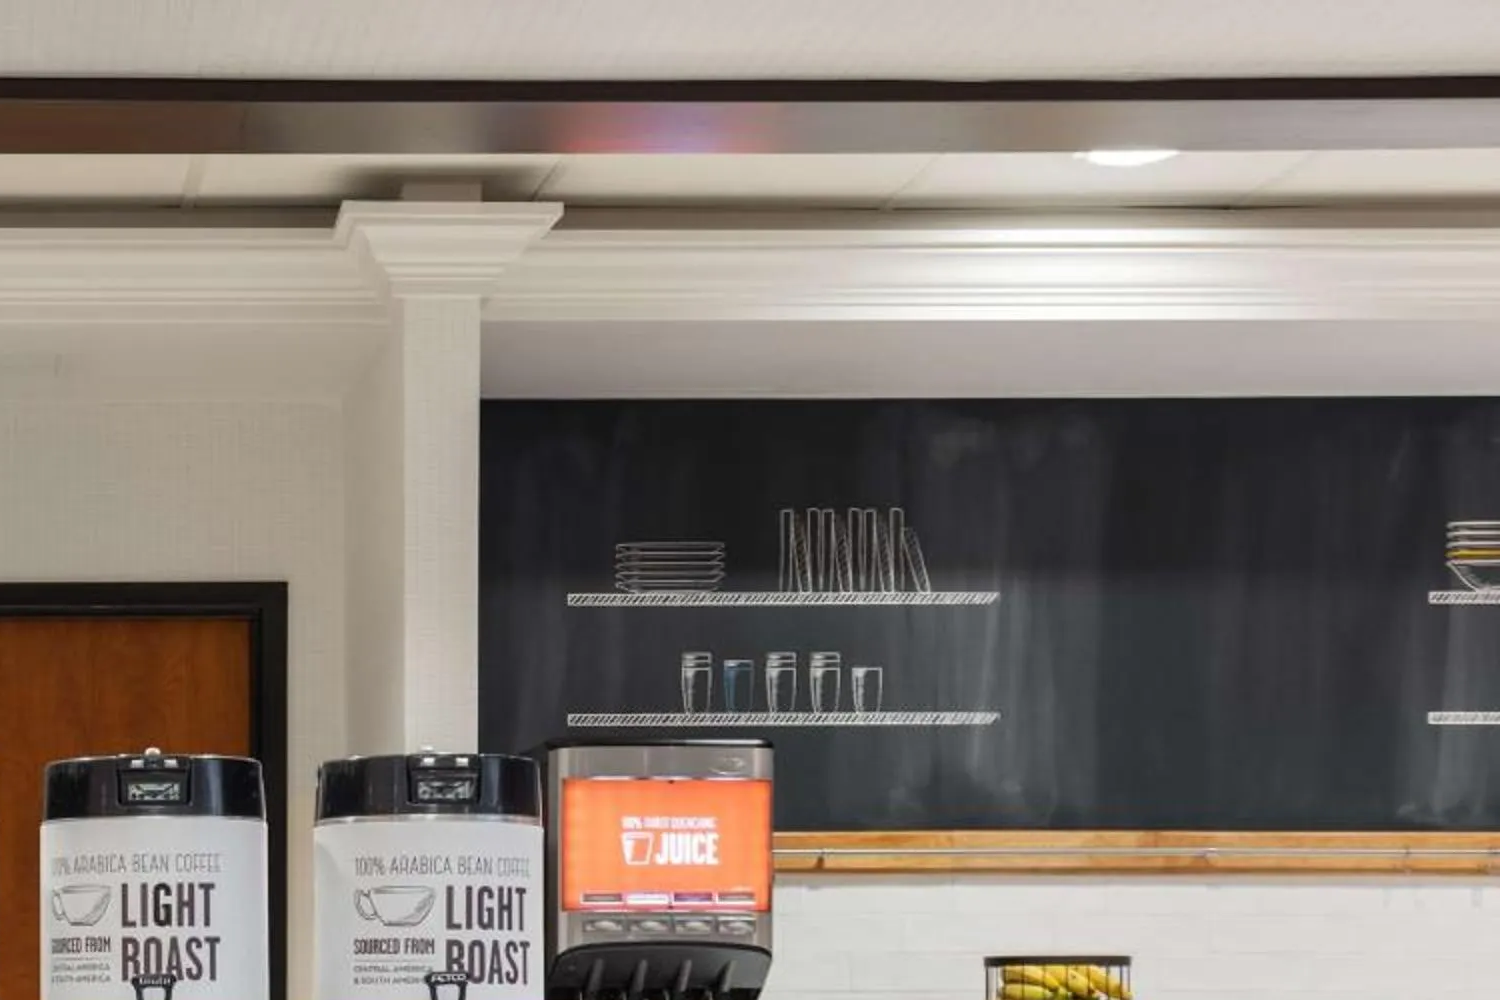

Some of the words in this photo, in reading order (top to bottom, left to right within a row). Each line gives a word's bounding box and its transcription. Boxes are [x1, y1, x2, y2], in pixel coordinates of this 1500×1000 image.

[74, 853, 127, 874] ARABICA
[132, 853, 169, 873] BEAN
[175, 853, 221, 873] COFFEE
[655, 832, 720, 865] JUICE
[355, 857, 385, 877] 100%
[390, 855, 452, 876] ARABICA
[457, 856, 493, 876] BEAN
[497, 857, 531, 878] COFFEE
[121, 882, 215, 927] LIGHT
[445, 885, 527, 931] LIGHT
[85, 936, 111, 953] FROM
[121, 936, 221, 982] ROAST
[353, 938, 400, 955] SOURCED
[404, 938, 435, 955] FROM
[445, 938, 531, 985] ROAST
